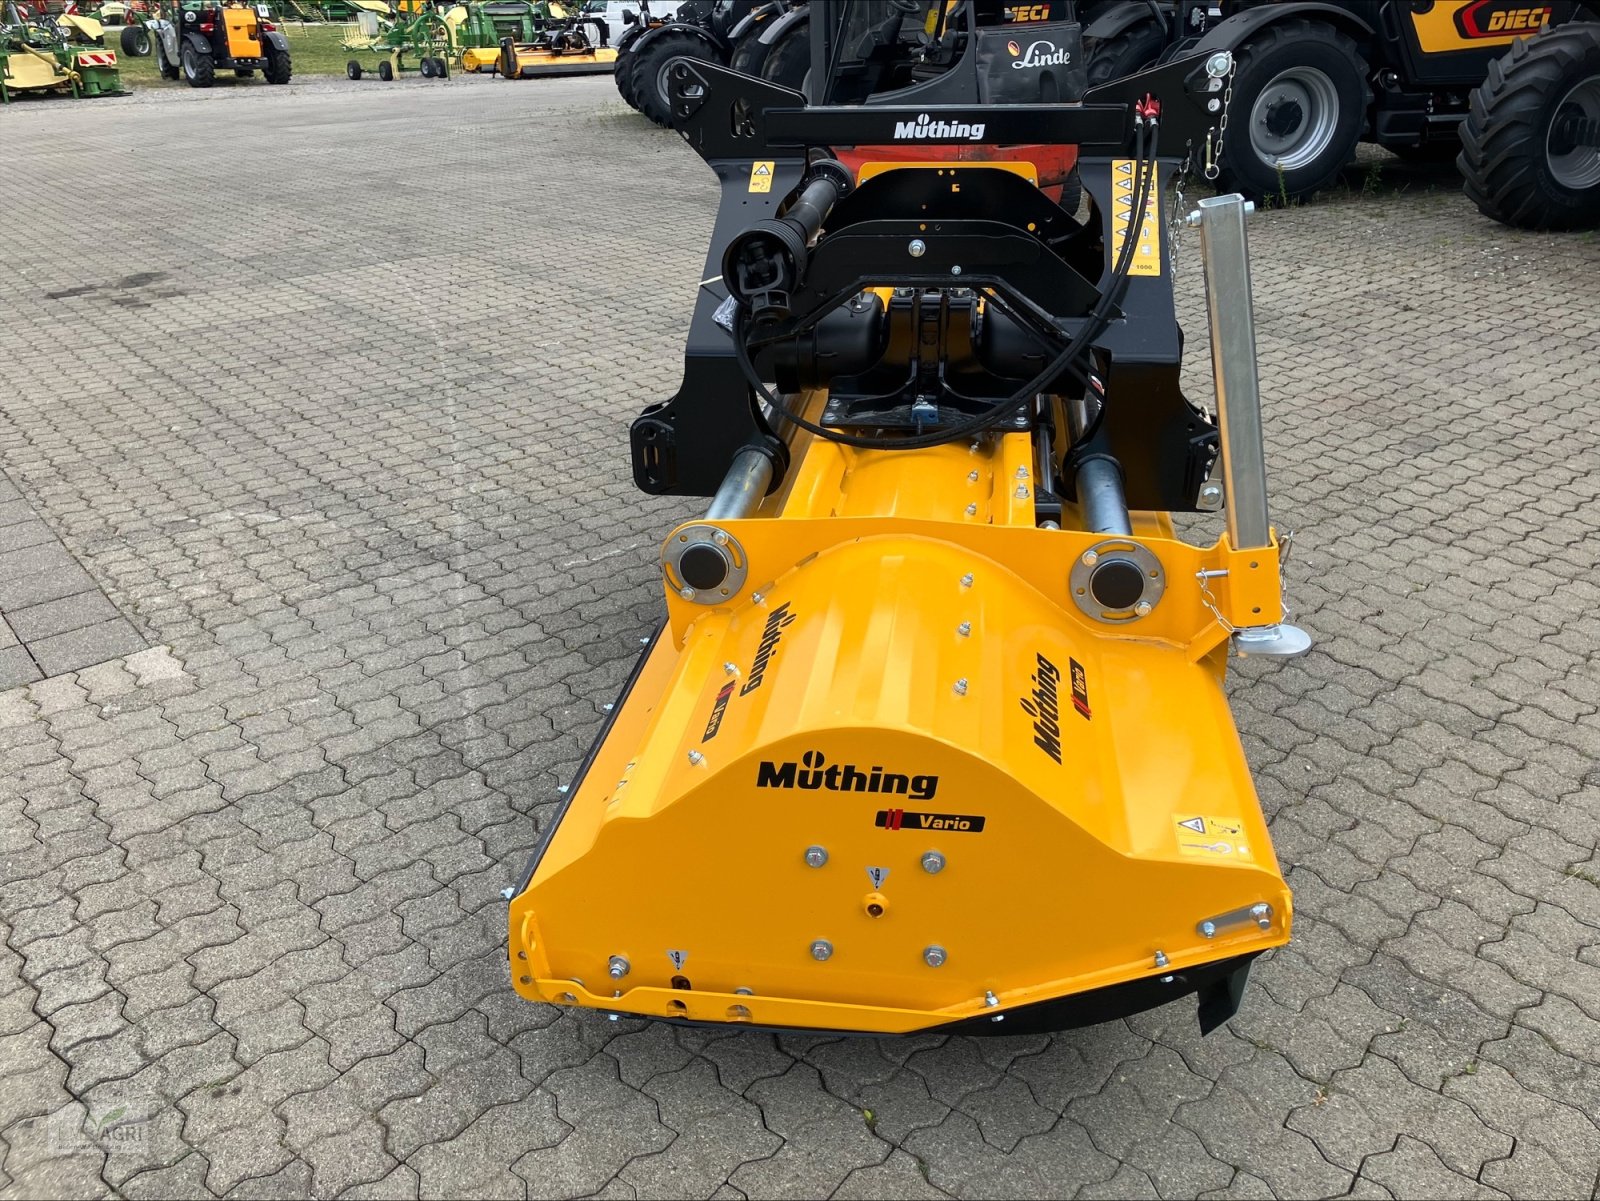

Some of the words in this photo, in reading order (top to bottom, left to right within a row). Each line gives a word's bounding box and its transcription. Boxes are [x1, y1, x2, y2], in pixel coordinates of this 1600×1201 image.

[1488, 7, 1552, 32] DIECI
[1011, 40, 1071, 69] Linde
[1072, 667, 1087, 696] Vario
[706, 692, 727, 735] Vario
[919, 815, 972, 831] Vario
